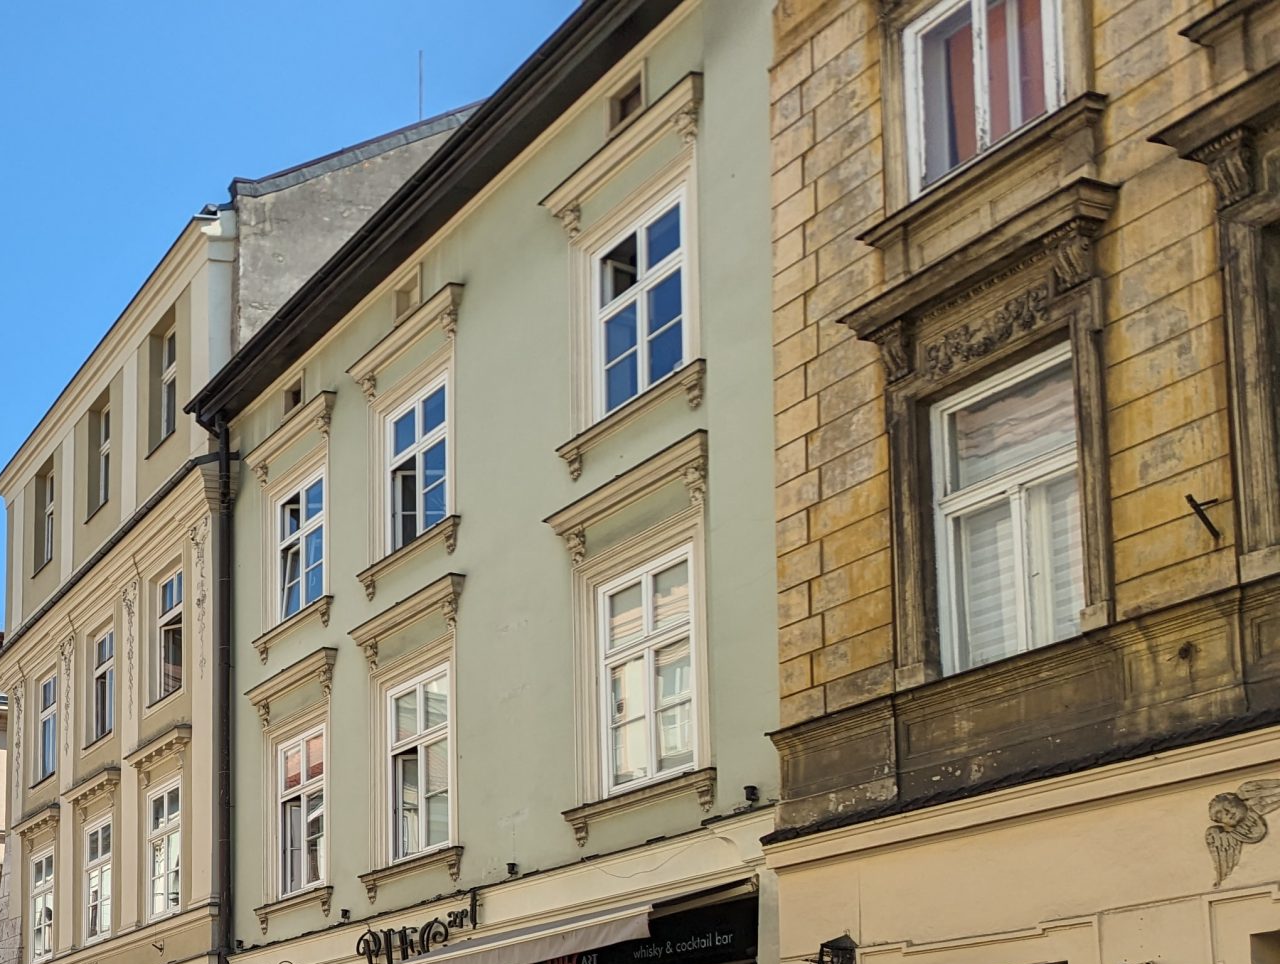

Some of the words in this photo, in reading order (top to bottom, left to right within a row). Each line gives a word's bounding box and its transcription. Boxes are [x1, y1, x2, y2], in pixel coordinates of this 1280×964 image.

[633, 945, 664, 960] whisky
[665, 941, 673, 954] &
[675, 934, 712, 952] cocktail
[716, 932, 734, 945] bar
